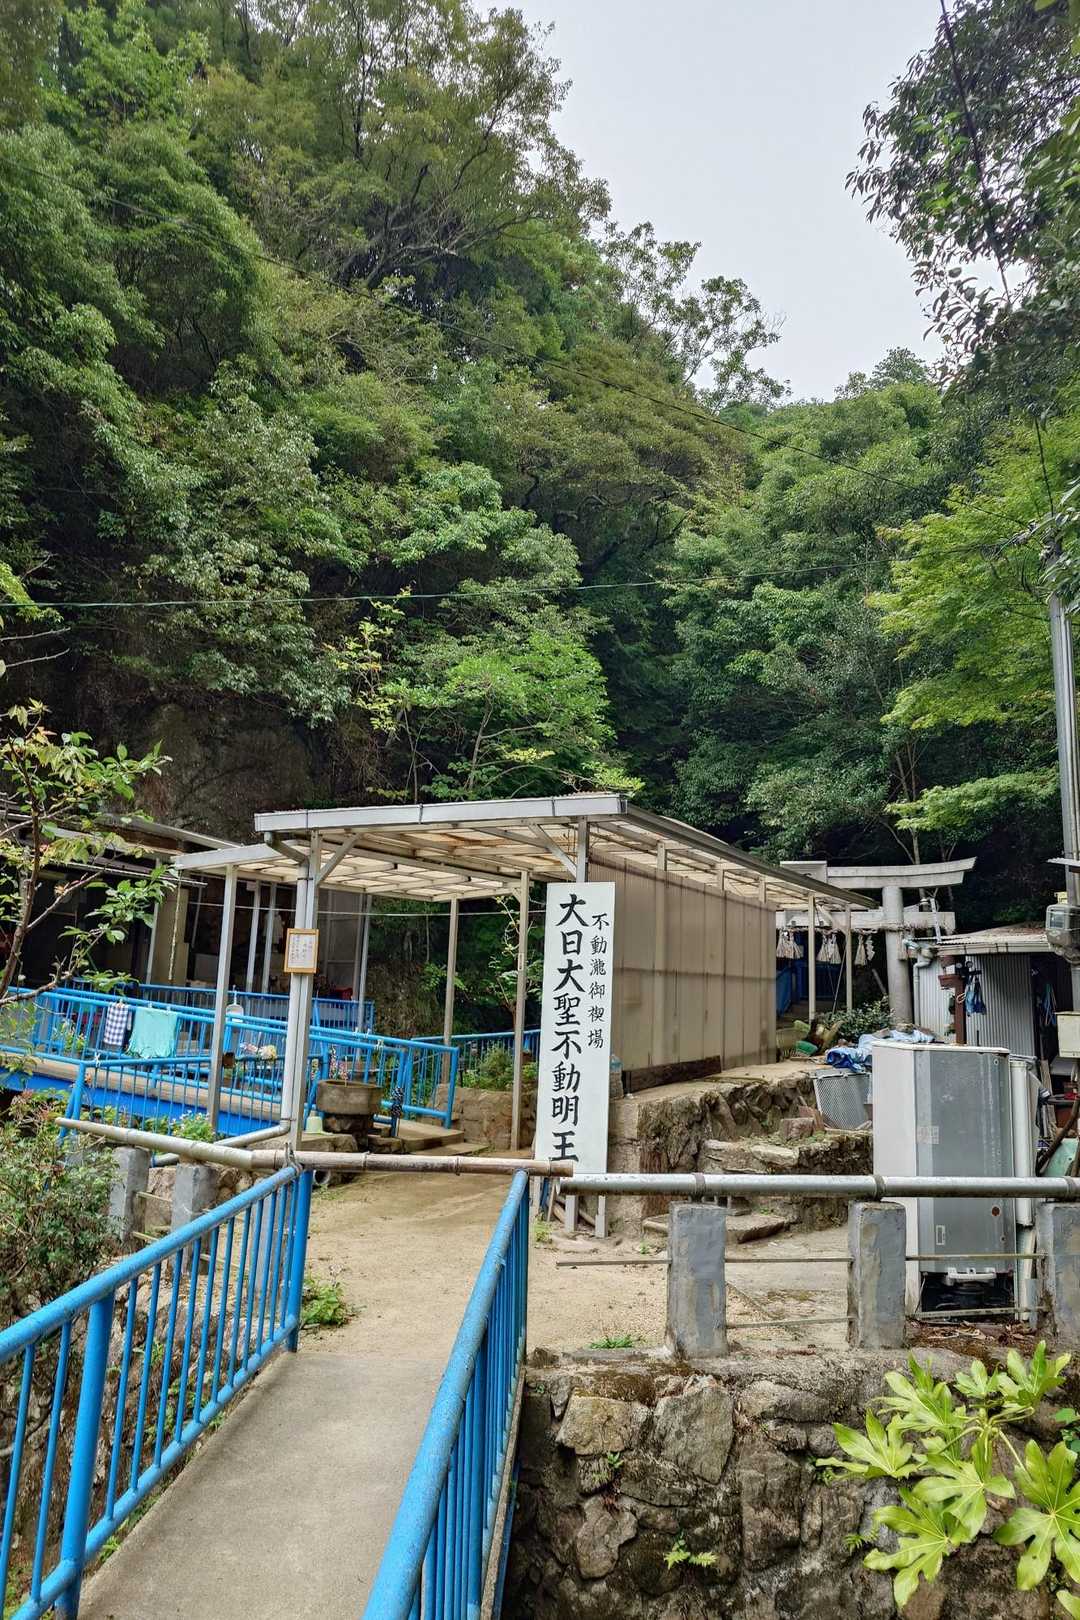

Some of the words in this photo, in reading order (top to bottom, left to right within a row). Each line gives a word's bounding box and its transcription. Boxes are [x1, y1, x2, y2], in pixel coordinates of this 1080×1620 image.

[549, 893, 589, 1162] 大日大聖不動明王
